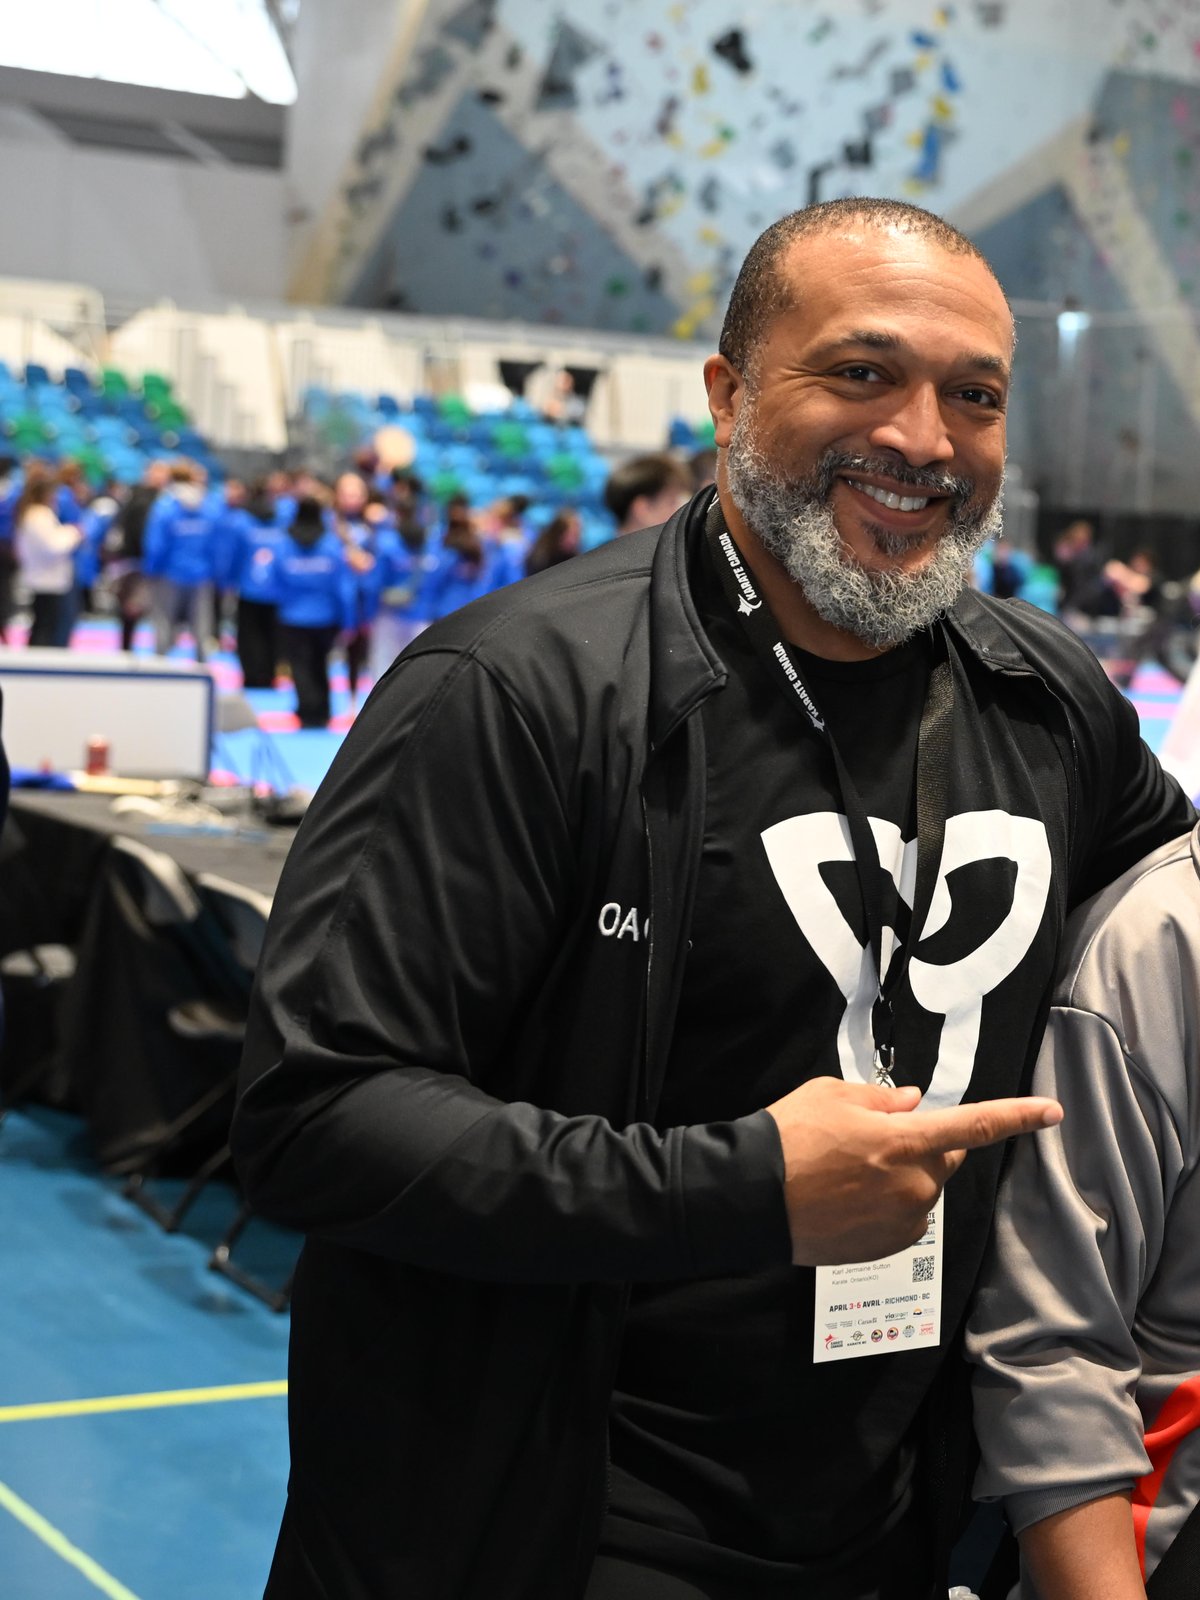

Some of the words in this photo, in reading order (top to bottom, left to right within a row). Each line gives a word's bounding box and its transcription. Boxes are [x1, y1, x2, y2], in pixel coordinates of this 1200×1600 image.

[718, 532, 741, 567] CANADA
[733, 566, 757, 601] KARATE
[772, 641, 798, 681] CANADA
[792, 680, 819, 717] KARATE
[598, 902, 650, 942] OA
[829, 1304, 848, 1312] APRIL
[862, 1299, 881, 1308] AVRIL
[884, 1294, 918, 1304] RICHMOND
